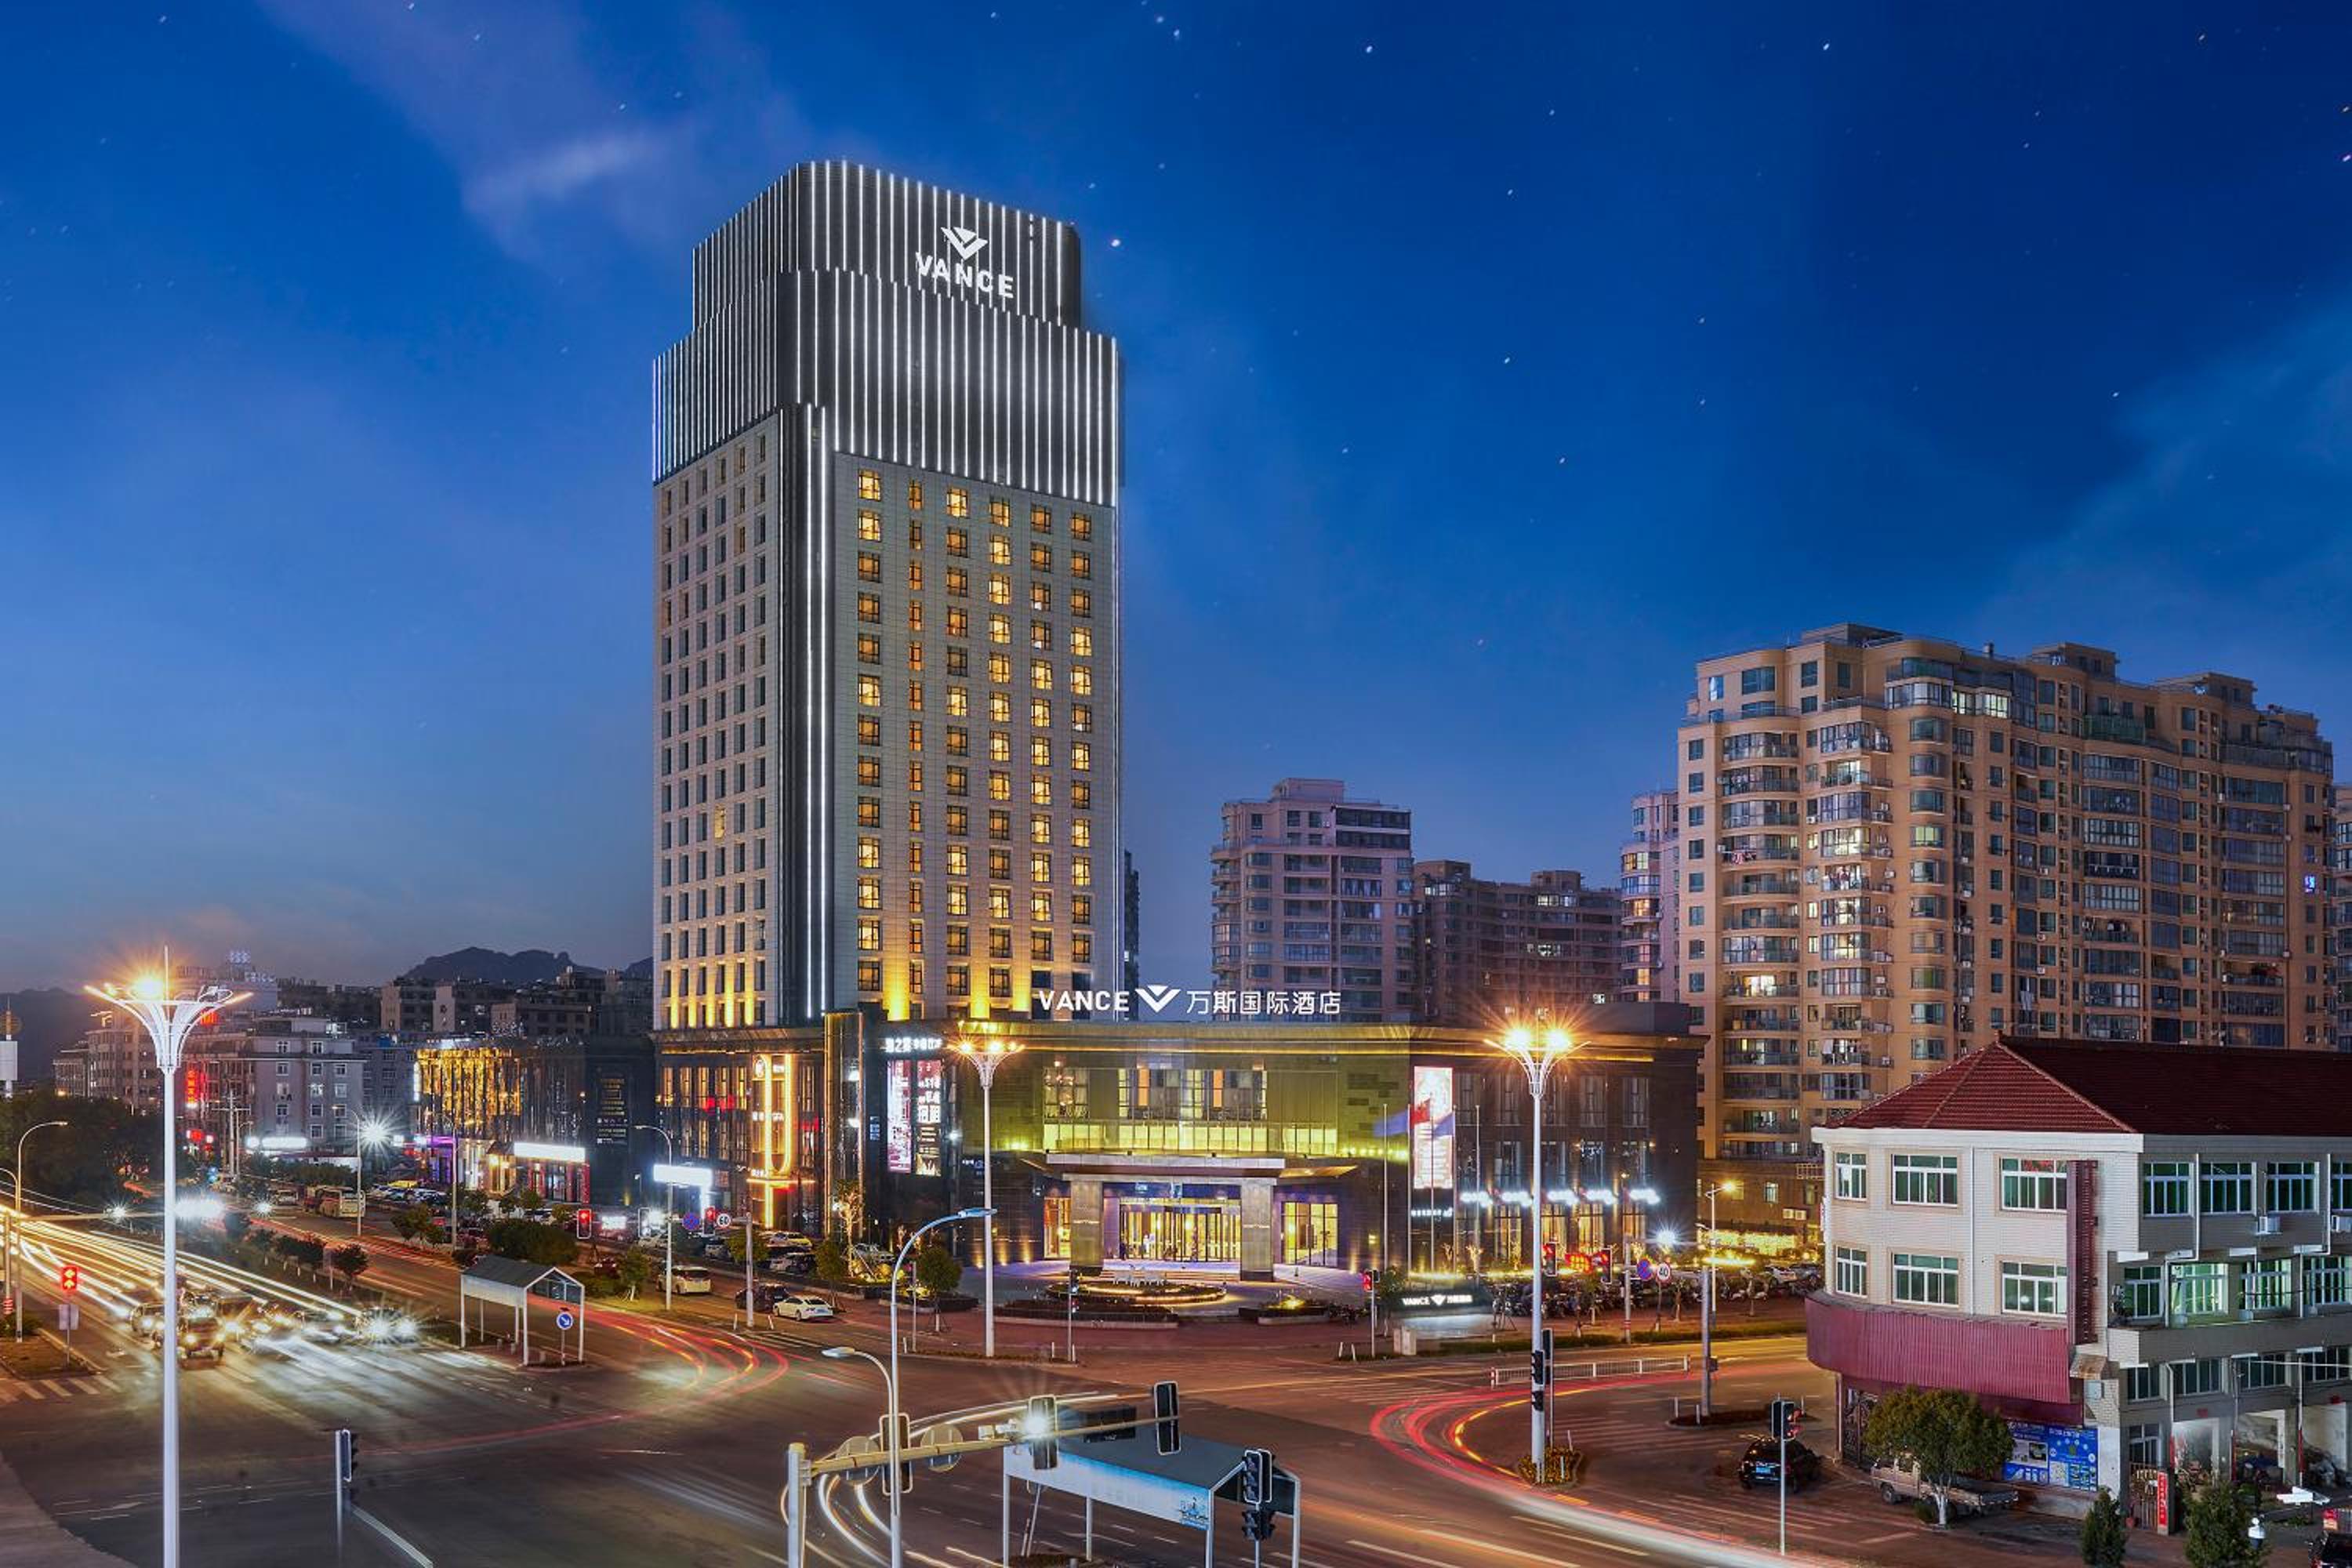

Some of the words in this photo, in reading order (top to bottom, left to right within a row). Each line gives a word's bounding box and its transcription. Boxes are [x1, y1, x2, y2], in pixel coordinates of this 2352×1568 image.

[915, 252, 1014, 299] VANCE
[1039, 990, 1129, 1012] VANCE
[1186, 990, 1341, 1014] 万斯国际酒店
[1659, 1267, 1668, 1276] 40
[1402, 1297, 1430, 1305] VANCE
